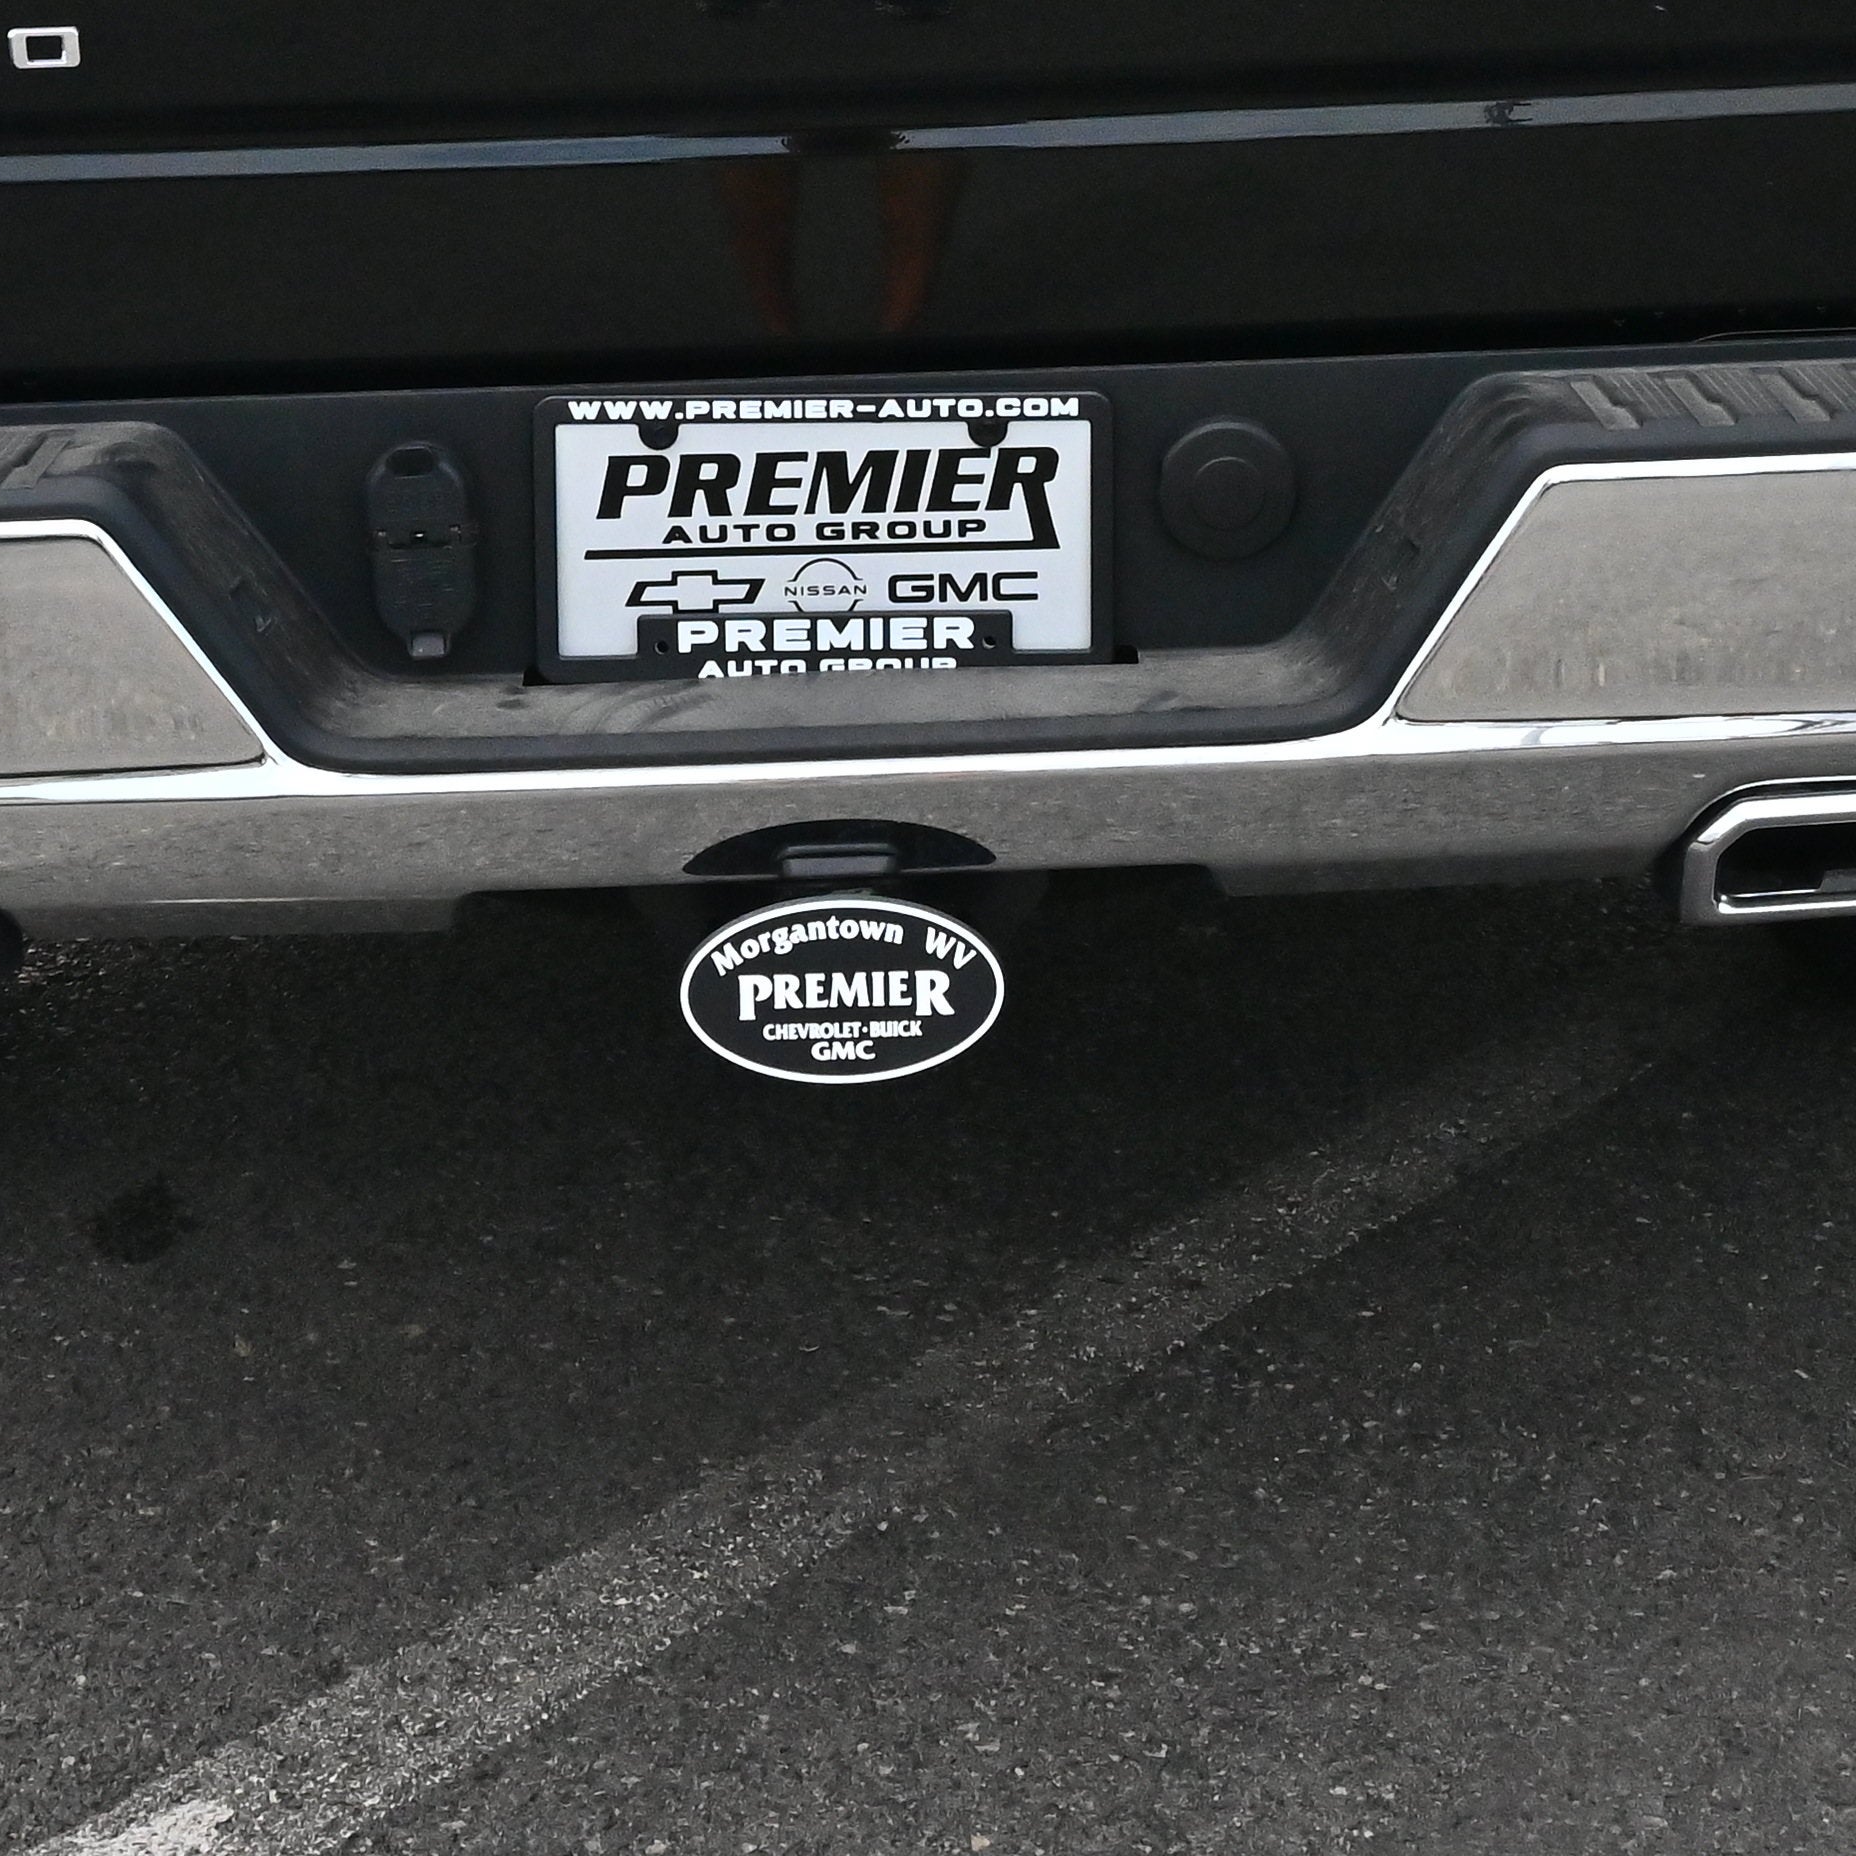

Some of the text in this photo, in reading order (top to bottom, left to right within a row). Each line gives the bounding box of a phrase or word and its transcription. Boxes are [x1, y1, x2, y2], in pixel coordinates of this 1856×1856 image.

[568, 397, 1080, 420] WWW.PREMIER-AUTO.COM
[595, 446, 1060, 549] PREMIER
[662, 519, 987, 544] AUTO GROUP
[784, 572, 1039, 603] NISSAN GMC
[677, 616, 975, 653] PREMIER
[697, 659, 807, 679] AUTO
[710, 915, 977, 976] Morgantown WV
[738, 970, 955, 1021] PREMIER
[811, 1041, 876, 1061] GMC
